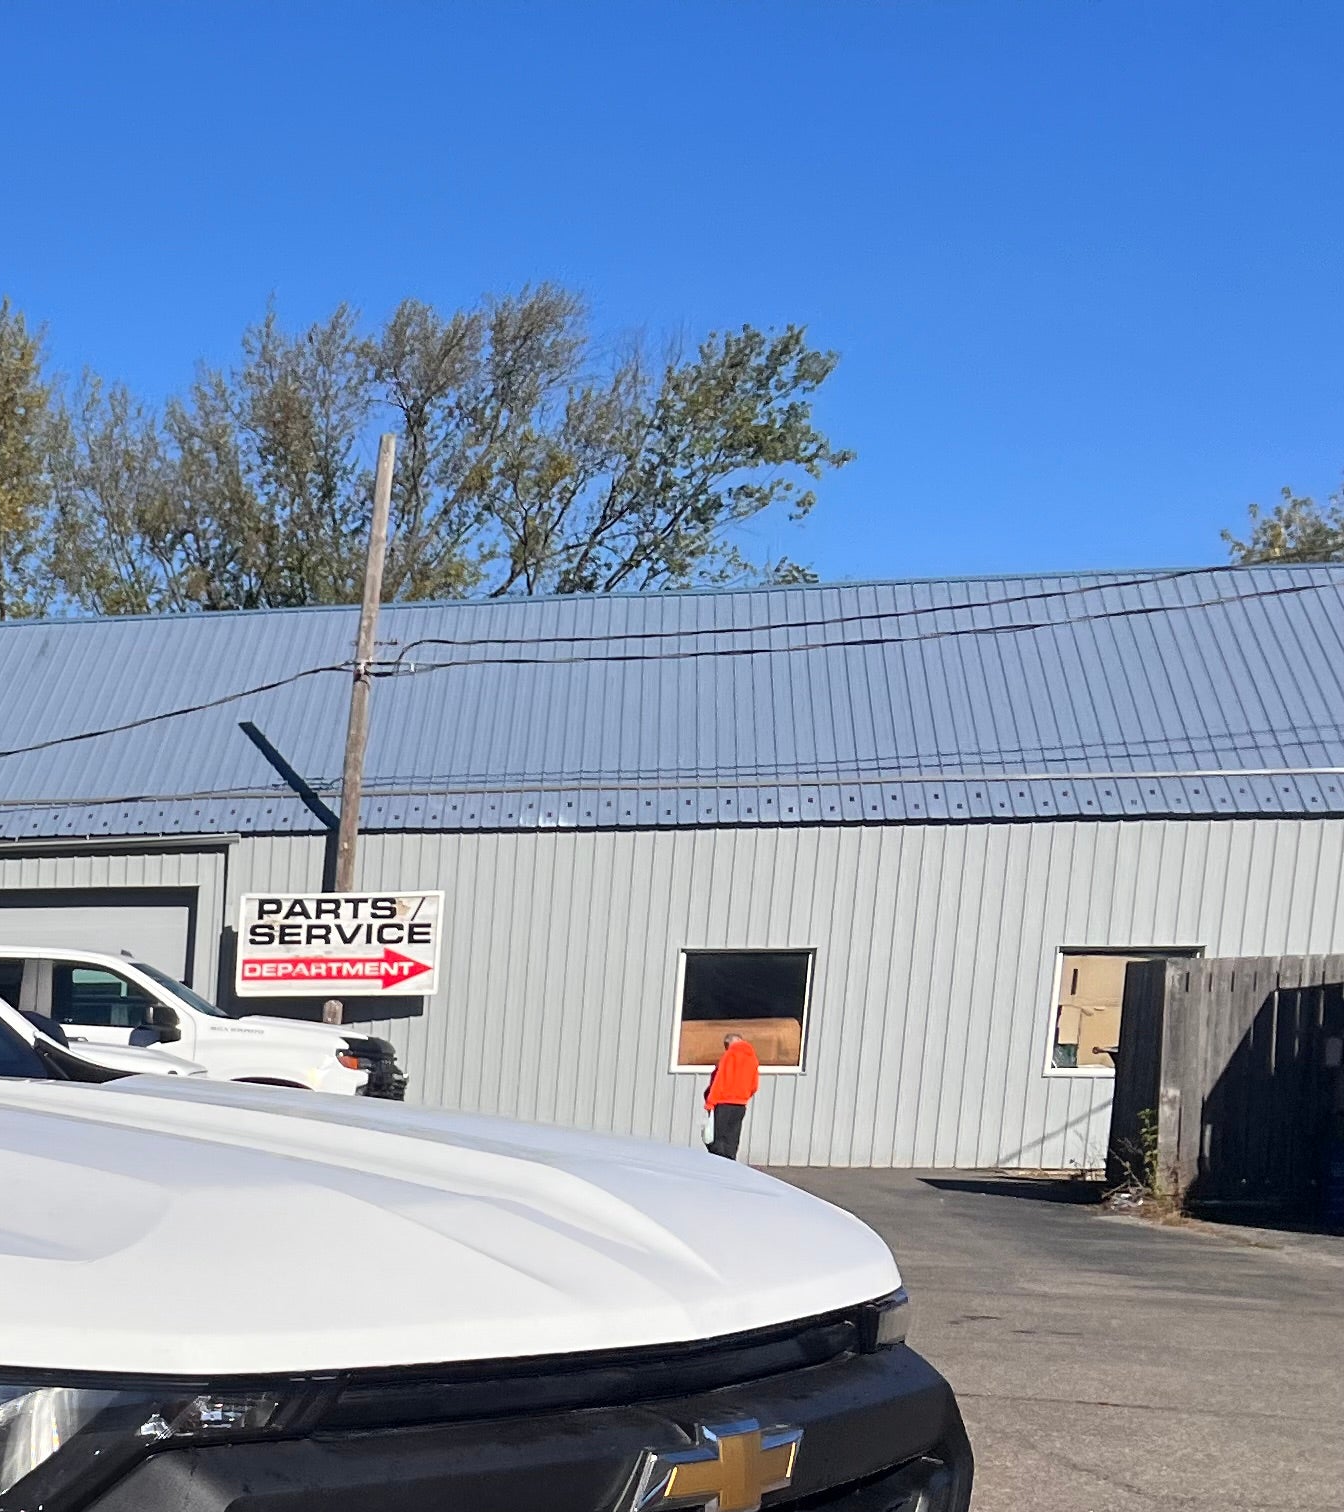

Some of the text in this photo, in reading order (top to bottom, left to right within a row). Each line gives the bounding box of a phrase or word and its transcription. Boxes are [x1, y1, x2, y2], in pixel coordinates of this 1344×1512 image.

[257, 897, 397, 921] PARTS
[248, 922, 432, 946] SERVICE
[243, 961, 415, 978] DEPARTMENT
